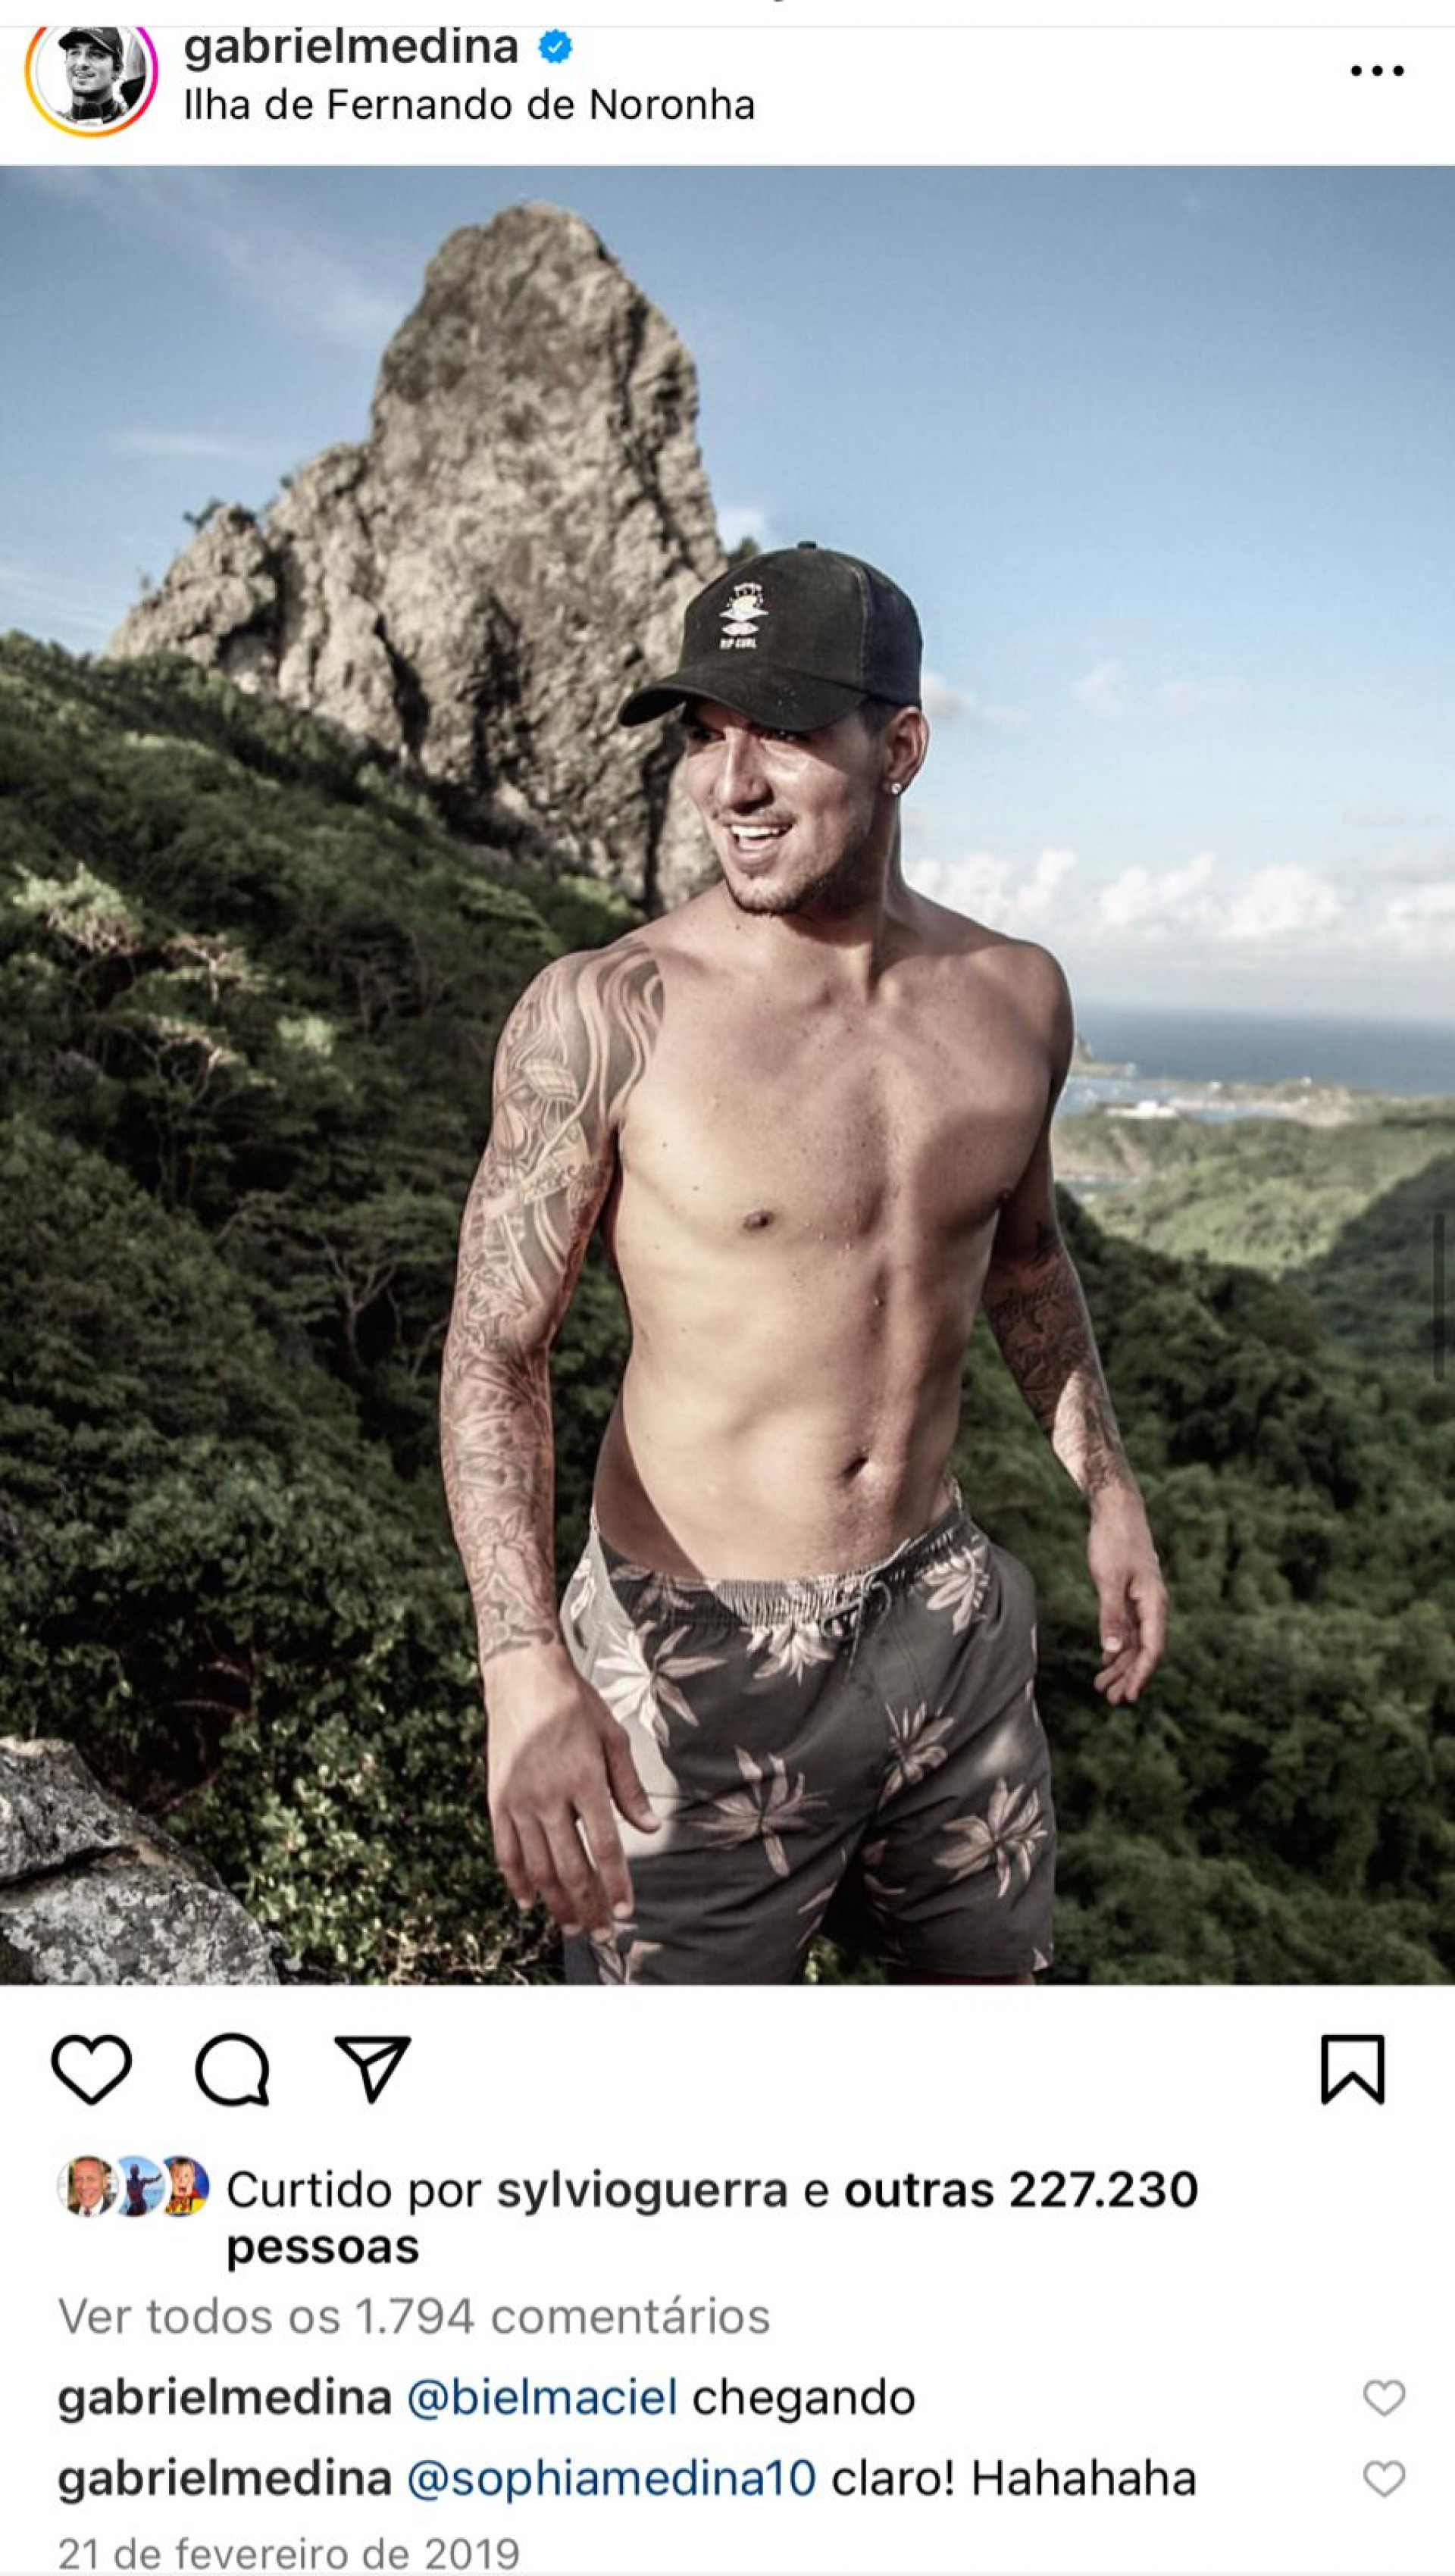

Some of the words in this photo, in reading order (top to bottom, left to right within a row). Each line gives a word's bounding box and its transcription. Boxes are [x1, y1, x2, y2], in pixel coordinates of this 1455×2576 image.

[184, 27, 518, 73] gabrielmedina
[186, 87, 250, 120] Ilha
[265, 87, 314, 120] de
[329, 87, 512, 120] Fernando
[527, 87, 575, 120] de
[591, 87, 754, 120] Noronha
[227, 2169, 392, 2209] Curtido
[410, 2180, 483, 2216] por
[497, 2168, 788, 2217] sylvioguerra
[804, 2180, 830, 2209] e
[844, 2173, 994, 2209] outras
[1010, 2170, 1198, 2209] 227.230
[227, 2235, 419, 2273] pessoas
[58, 2298, 133, 2334] Ver
[146, 2296, 273, 2334] todos
[289, 2307, 340, 2334] os
[356, 2297, 475, 2334] 1.794
[492, 2295, 770, 2334] comentários
[58, 2376, 392, 2424] gabrielmedina
[408, 2377, 677, 2422] @bielmaciel
[693, 2377, 915, 2424] chegando
[58, 2456, 392, 2505] gabrielmedina
[408, 2457, 817, 2505] @sophiamedina10
[831, 2458, 954, 2497] claro!
[973, 2457, 1197, 2496] Hahahaha
[59, 2537, 96, 2570] 21
[114, 2537, 161, 2570] de
[175, 2537, 349, 2570] fevereiro
[363, 2537, 409, 2570] de
[426, 2537, 519, 2571] 2019
